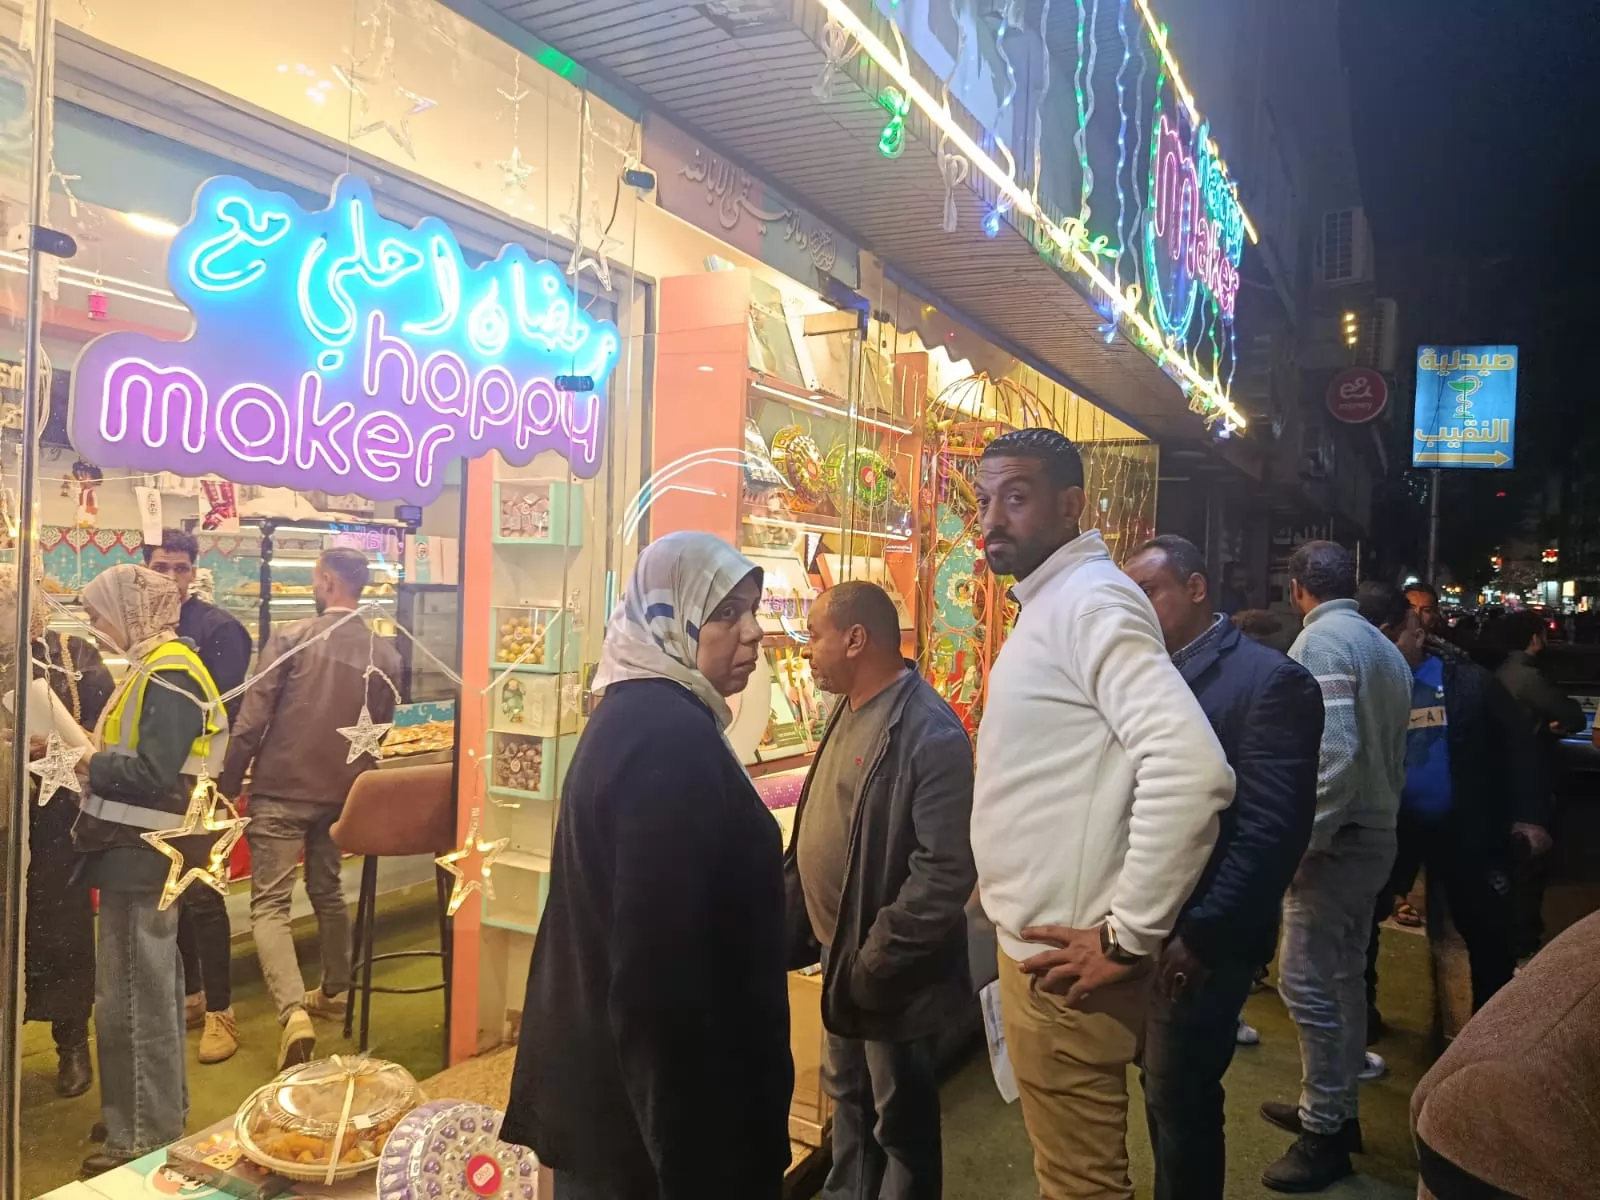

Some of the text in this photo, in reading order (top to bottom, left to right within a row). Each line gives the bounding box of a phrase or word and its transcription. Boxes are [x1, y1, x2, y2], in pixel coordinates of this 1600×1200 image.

[188, 196, 292, 293] مع
[467, 259, 617, 384] رمضان
[1418, 347, 1515, 377] صيدلية
[99, 356, 455, 487] maker
[363, 309, 600, 464] happy
[1414, 418, 1510, 448] النقيب
